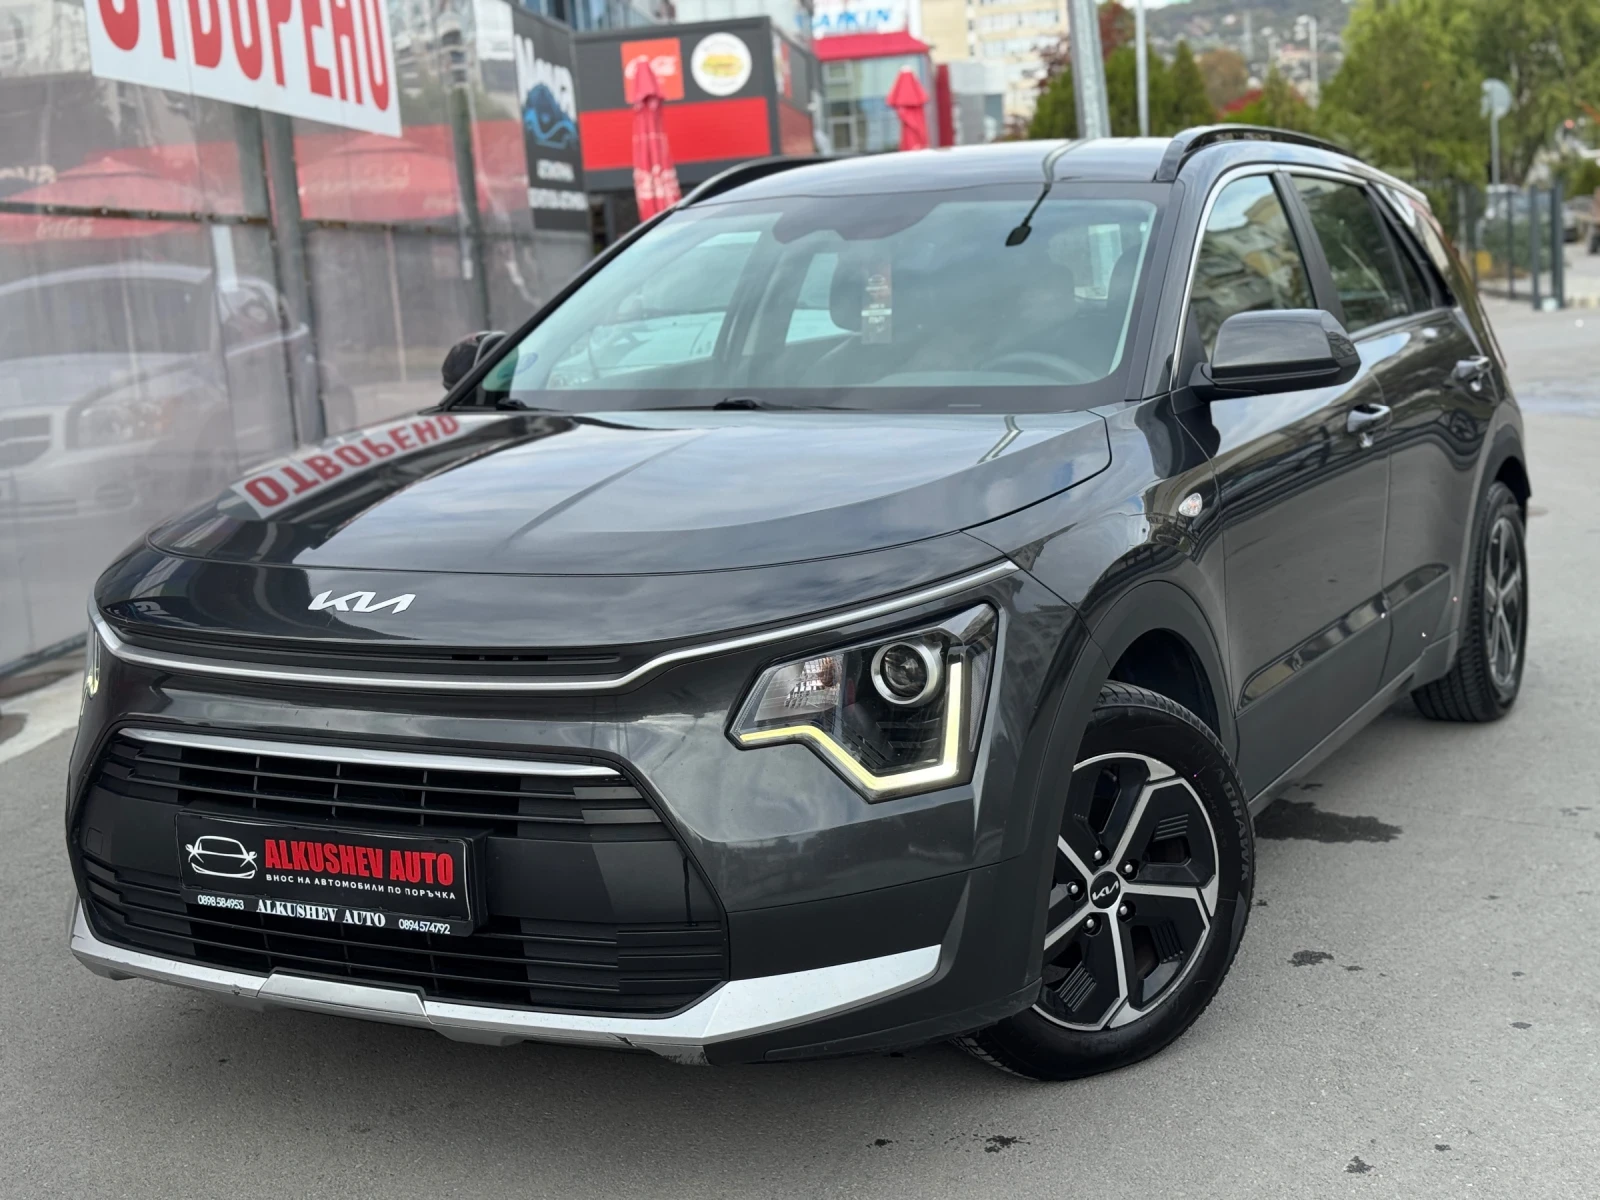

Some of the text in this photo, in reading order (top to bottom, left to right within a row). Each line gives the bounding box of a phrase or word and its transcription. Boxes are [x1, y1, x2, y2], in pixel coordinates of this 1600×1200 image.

[98, 0, 390, 112] ОРЕНО
[264, 839, 454, 886] ALKUSHEV AUTO
[266, 873, 456, 900] ВНОС НА АВТОМОБИЛИ ПО ПОРЪЧКА
[256, 898, 386, 928] ALKUSHEV AUTO
